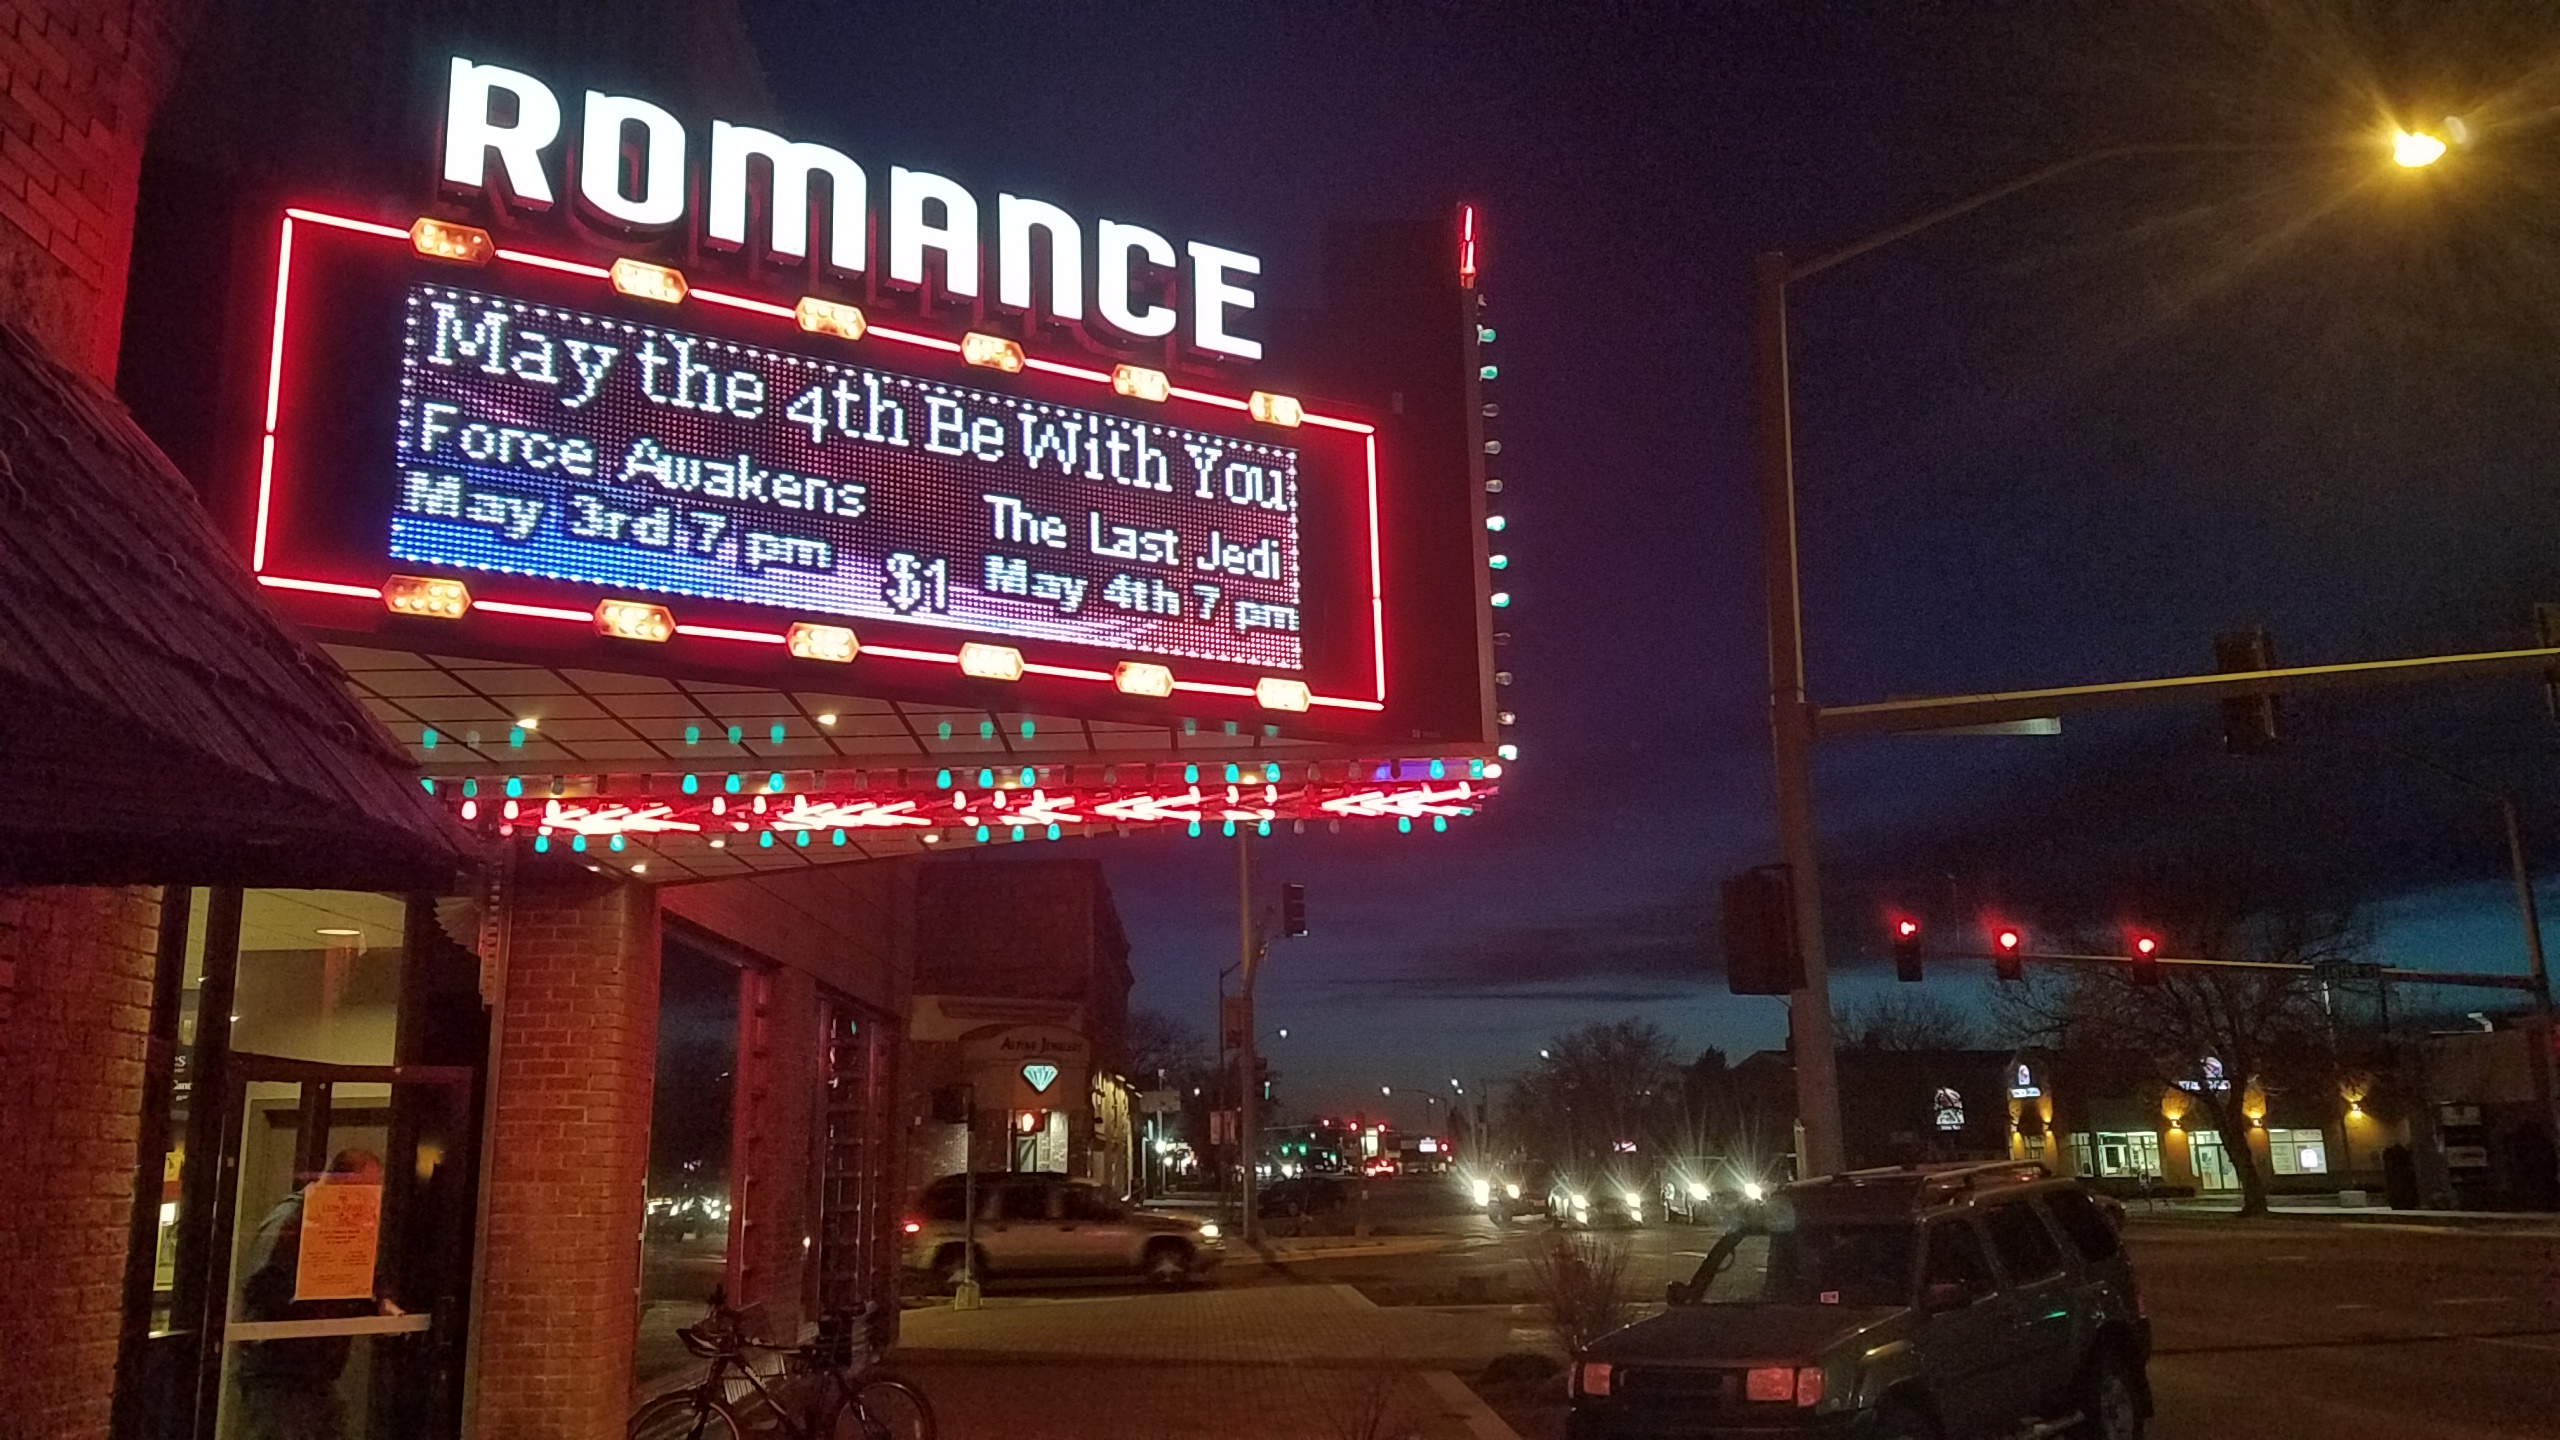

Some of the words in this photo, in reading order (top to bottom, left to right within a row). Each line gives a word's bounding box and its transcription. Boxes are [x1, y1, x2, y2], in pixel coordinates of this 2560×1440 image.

[443, 56, 1264, 362] ROMANCE
[428, 302, 618, 408] May
[636, 334, 765, 419] the
[787, 368, 910, 447] 4th
[925, 394, 1005, 462] Be
[1018, 412, 1173, 493] With
[1184, 443, 1289, 512] You
[421, 402, 598, 477] Force
[618, 437, 868, 518] Awakens
[402, 470, 545, 540] May
[568, 495, 675, 546] 3rd
[688, 511, 728, 553] 7
[746, 532, 835, 572] pm
[983, 494, 1068, 549] The
[1090, 511, 1181, 566] Last
[1197, 531, 1281, 580] Jedi
[886, 553, 948, 611] $1
[984, 554, 1090, 612] May
[1103, 574, 1181, 616] 4th
[1193, 584, 1220, 620] 7
[1234, 600, 1302, 634] pm
